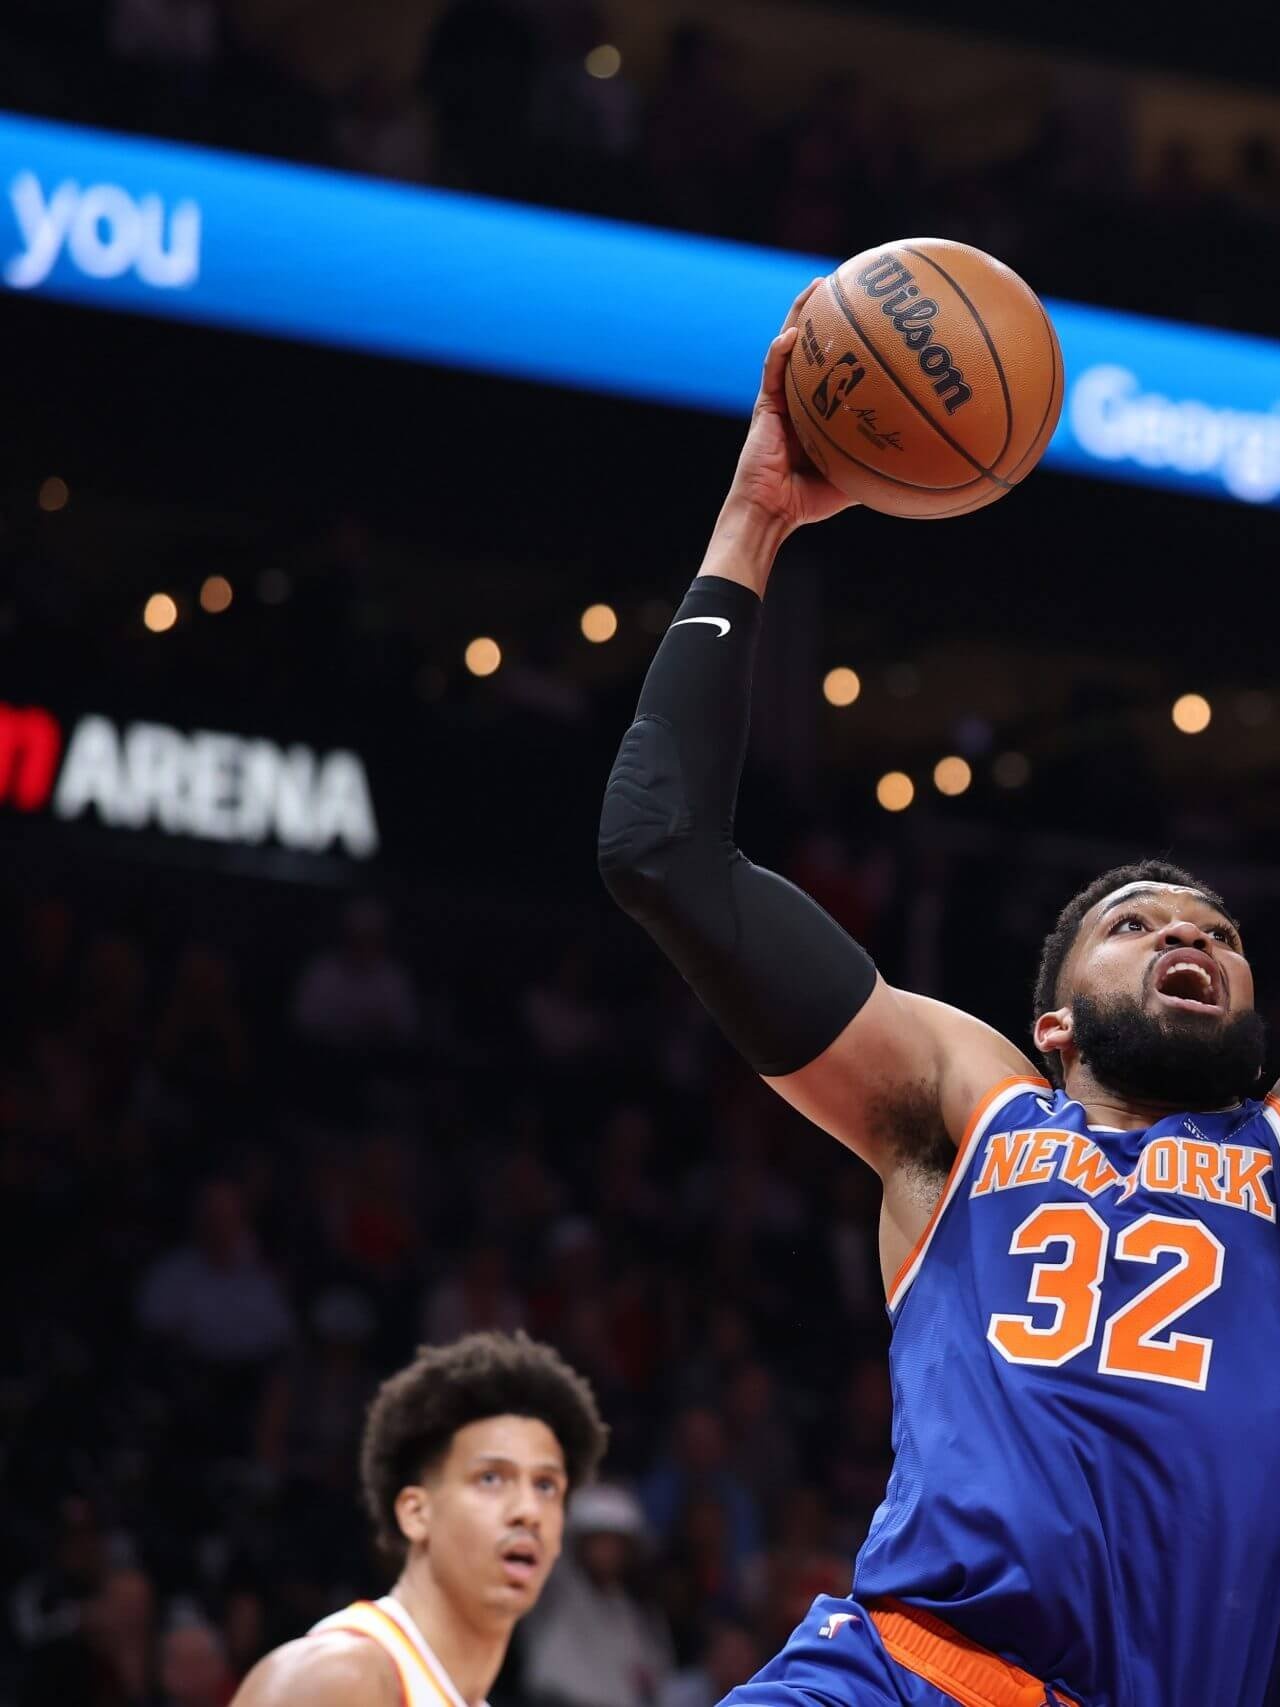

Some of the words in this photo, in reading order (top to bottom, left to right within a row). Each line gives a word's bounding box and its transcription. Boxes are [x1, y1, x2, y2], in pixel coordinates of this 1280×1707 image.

[4, 170, 201, 289] you
[856, 253, 972, 416] Wilson
[55, 713, 378, 858] ARENA
[970, 1128, 1121, 1199] NEW
[986, 1202, 1226, 1391] 32
